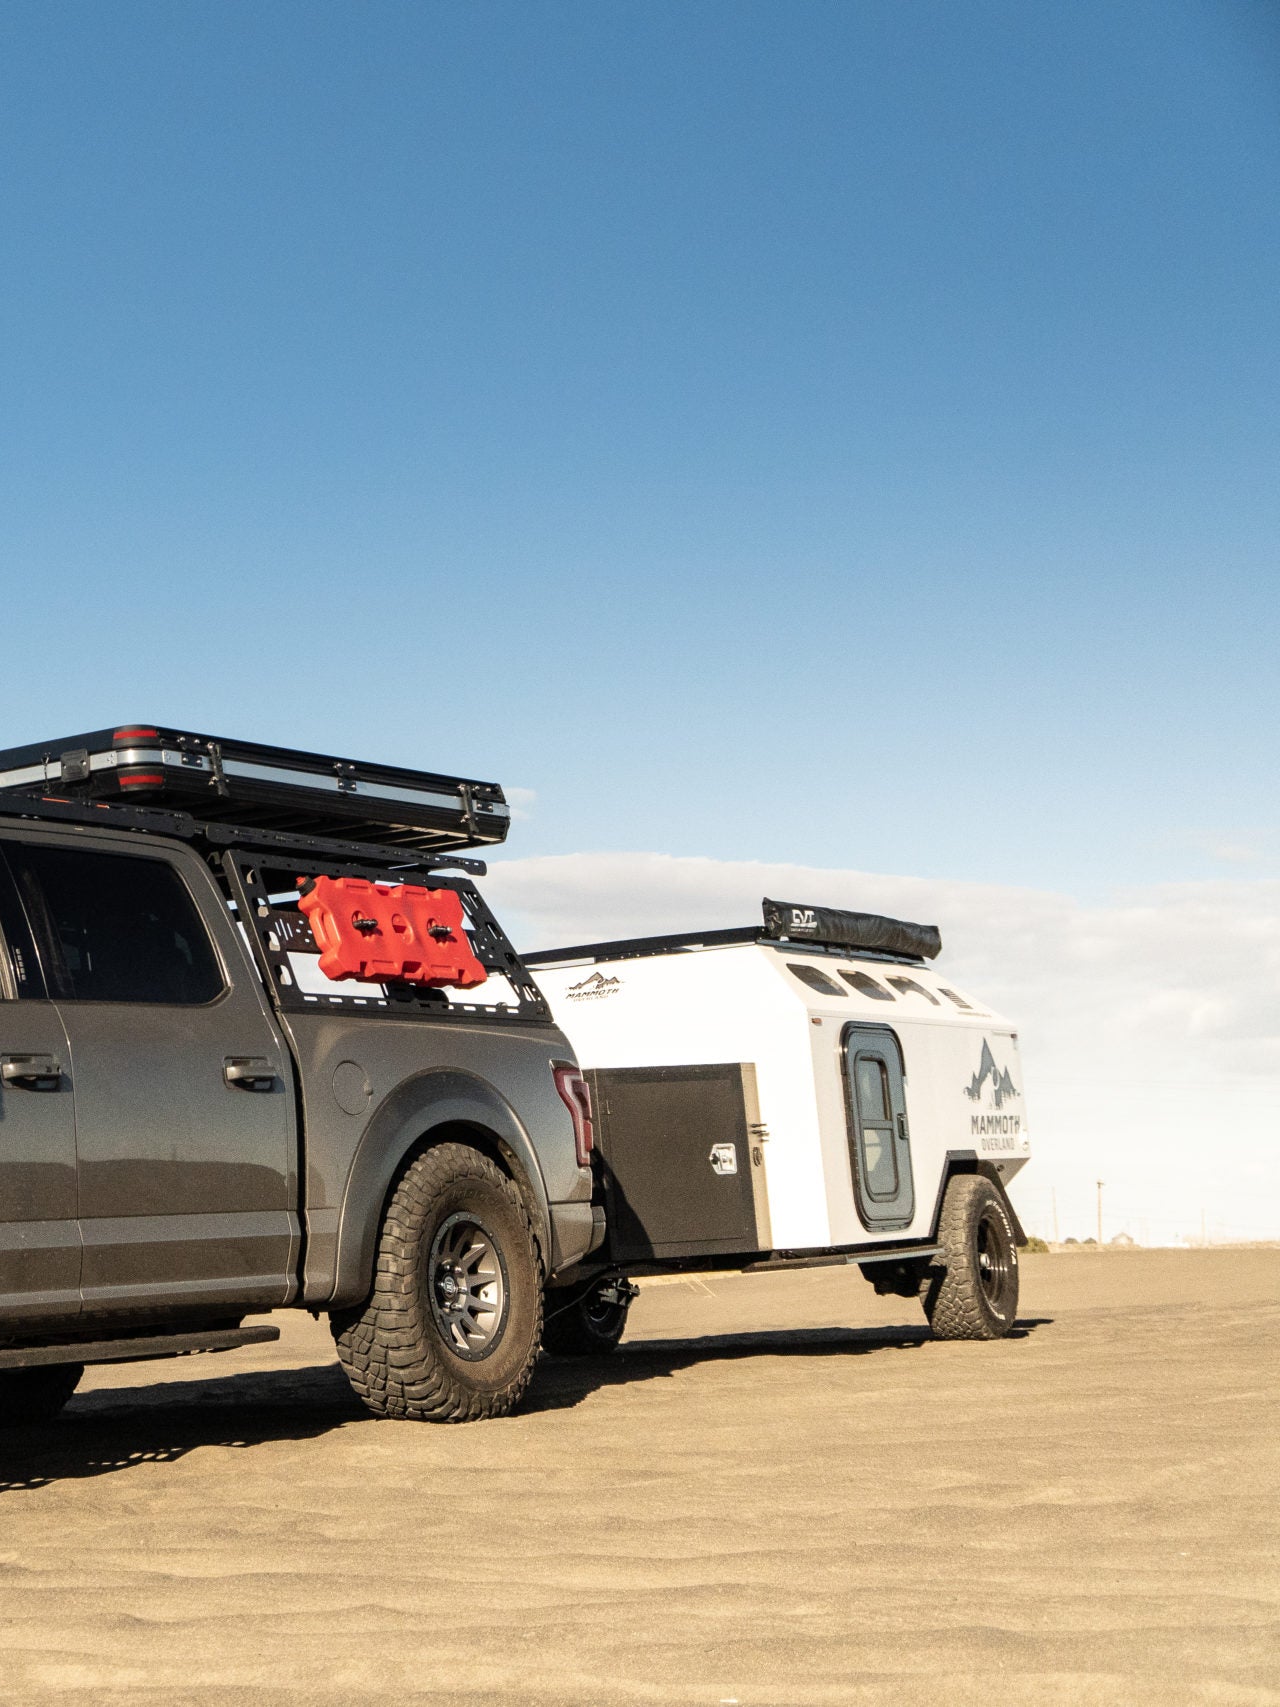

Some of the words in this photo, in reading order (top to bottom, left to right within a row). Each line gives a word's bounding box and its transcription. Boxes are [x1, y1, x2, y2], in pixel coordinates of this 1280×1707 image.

[565, 988, 620, 1000] MAMMOTH
[971, 1115, 1020, 1135] MAMMOTH
[981, 1137, 1015, 1151] OVERLAND
